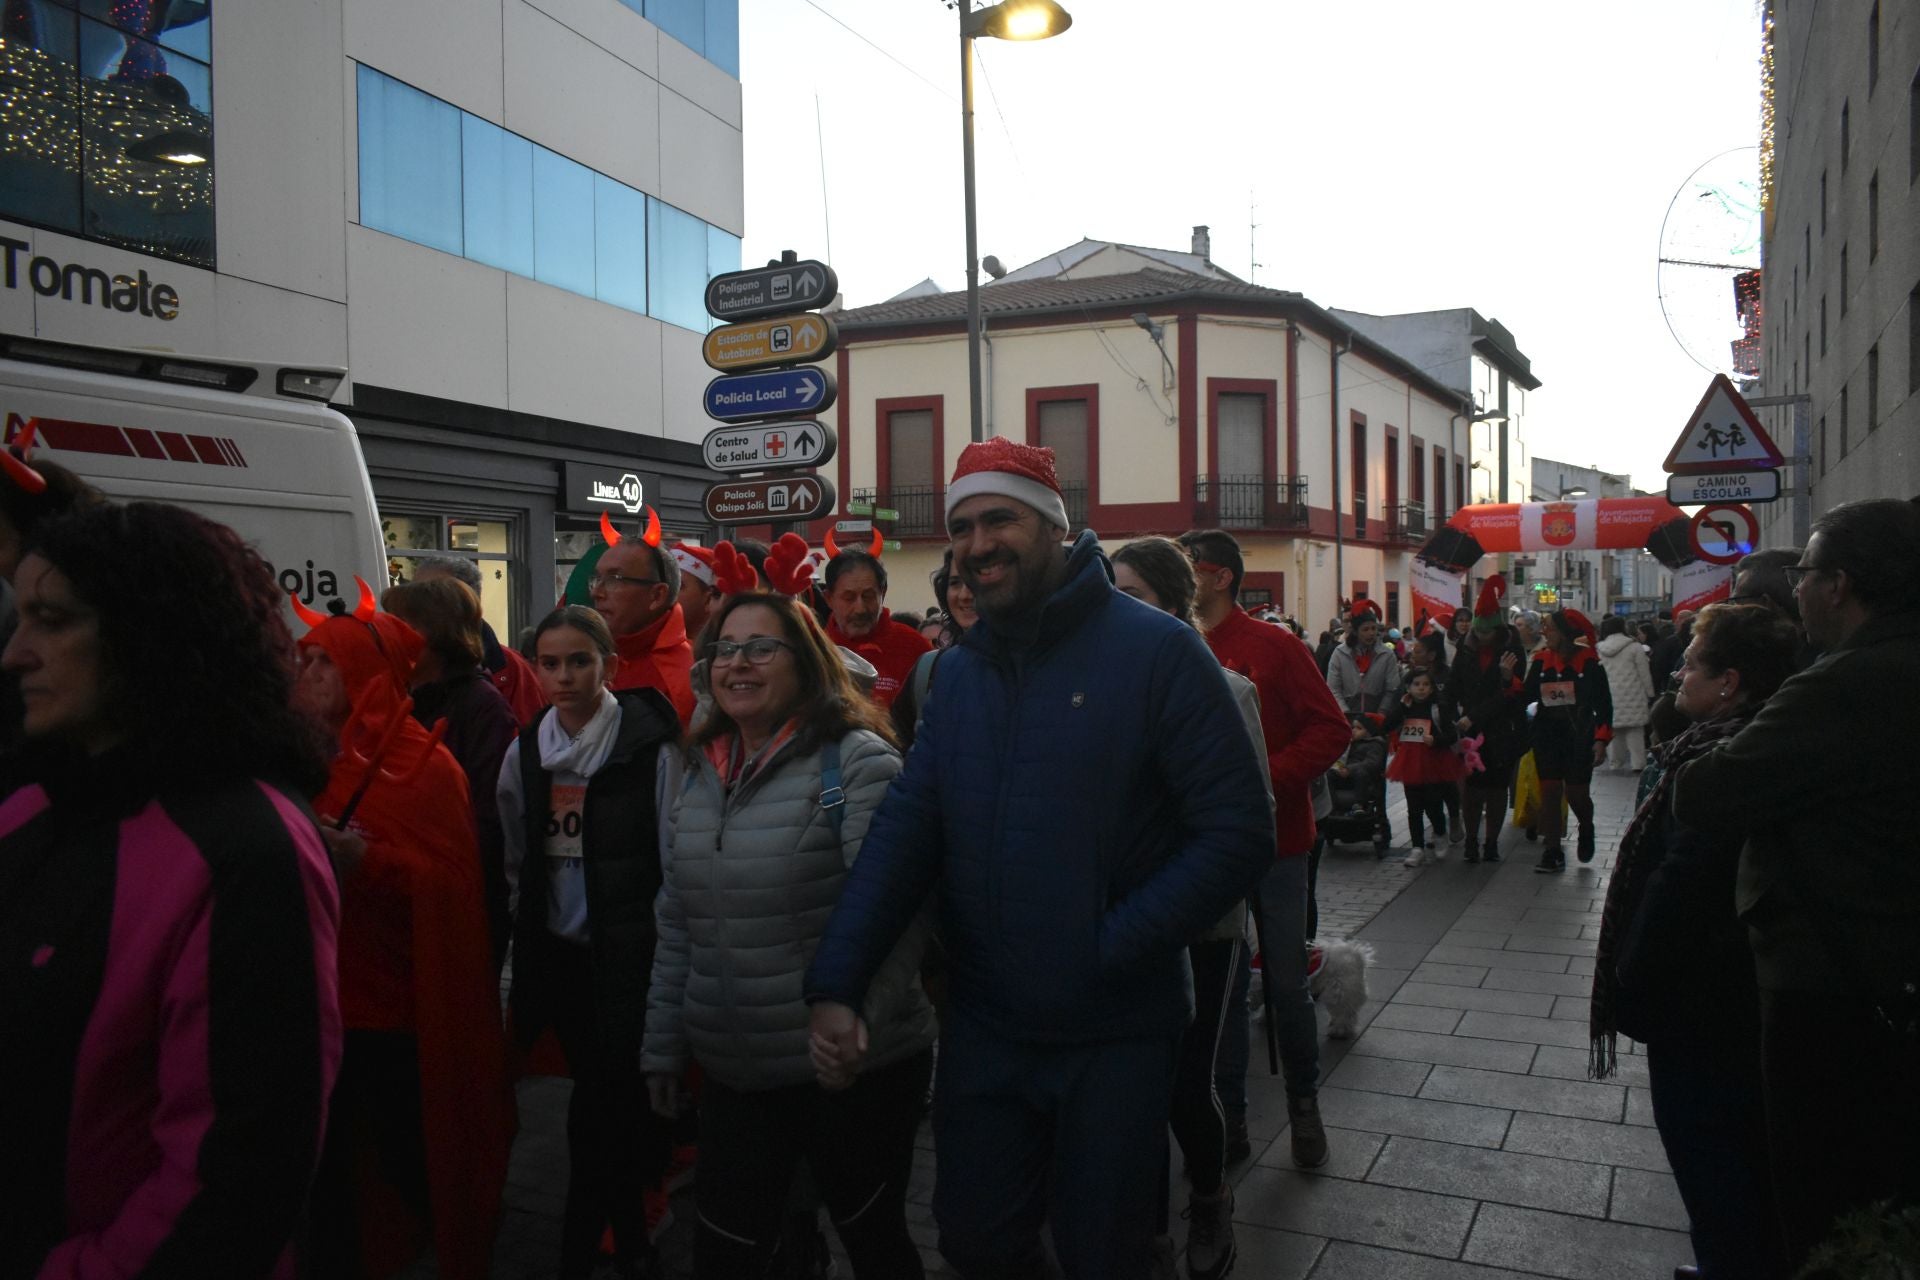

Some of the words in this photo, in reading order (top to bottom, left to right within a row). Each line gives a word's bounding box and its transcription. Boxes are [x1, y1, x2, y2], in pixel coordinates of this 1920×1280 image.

[0, 236, 179, 321] Tomate
[719, 281, 760, 295] Polígono
[719, 293, 764, 310] Industrial
[717, 333, 753, 346] Estación
[756, 329, 769, 339] de
[717, 347, 763, 360] Autobuses
[756, 387, 786, 401] Local
[715, 437, 749, 448] Centro
[715, 452, 728, 463] de
[730, 449, 758, 462] Salud
[1697, 475, 1747, 488] CAMINO
[622, 482, 640, 502] 4.0
[724, 489, 756, 500] Palacio
[1693, 487, 1752, 500] ESCOLAR
[715, 503, 745, 512] Obispo
[746, 500, 765, 510] Solís
[1599, 509, 1655, 517] Ayuntamiento
[1613, 515, 1653, 524] Miajadas
[1471, 520, 1481, 528] de
[1483, 519, 1518, 529] Miajadas
[1550, 690, 1565, 700] 34
[1403, 726, 1424, 737] 229
